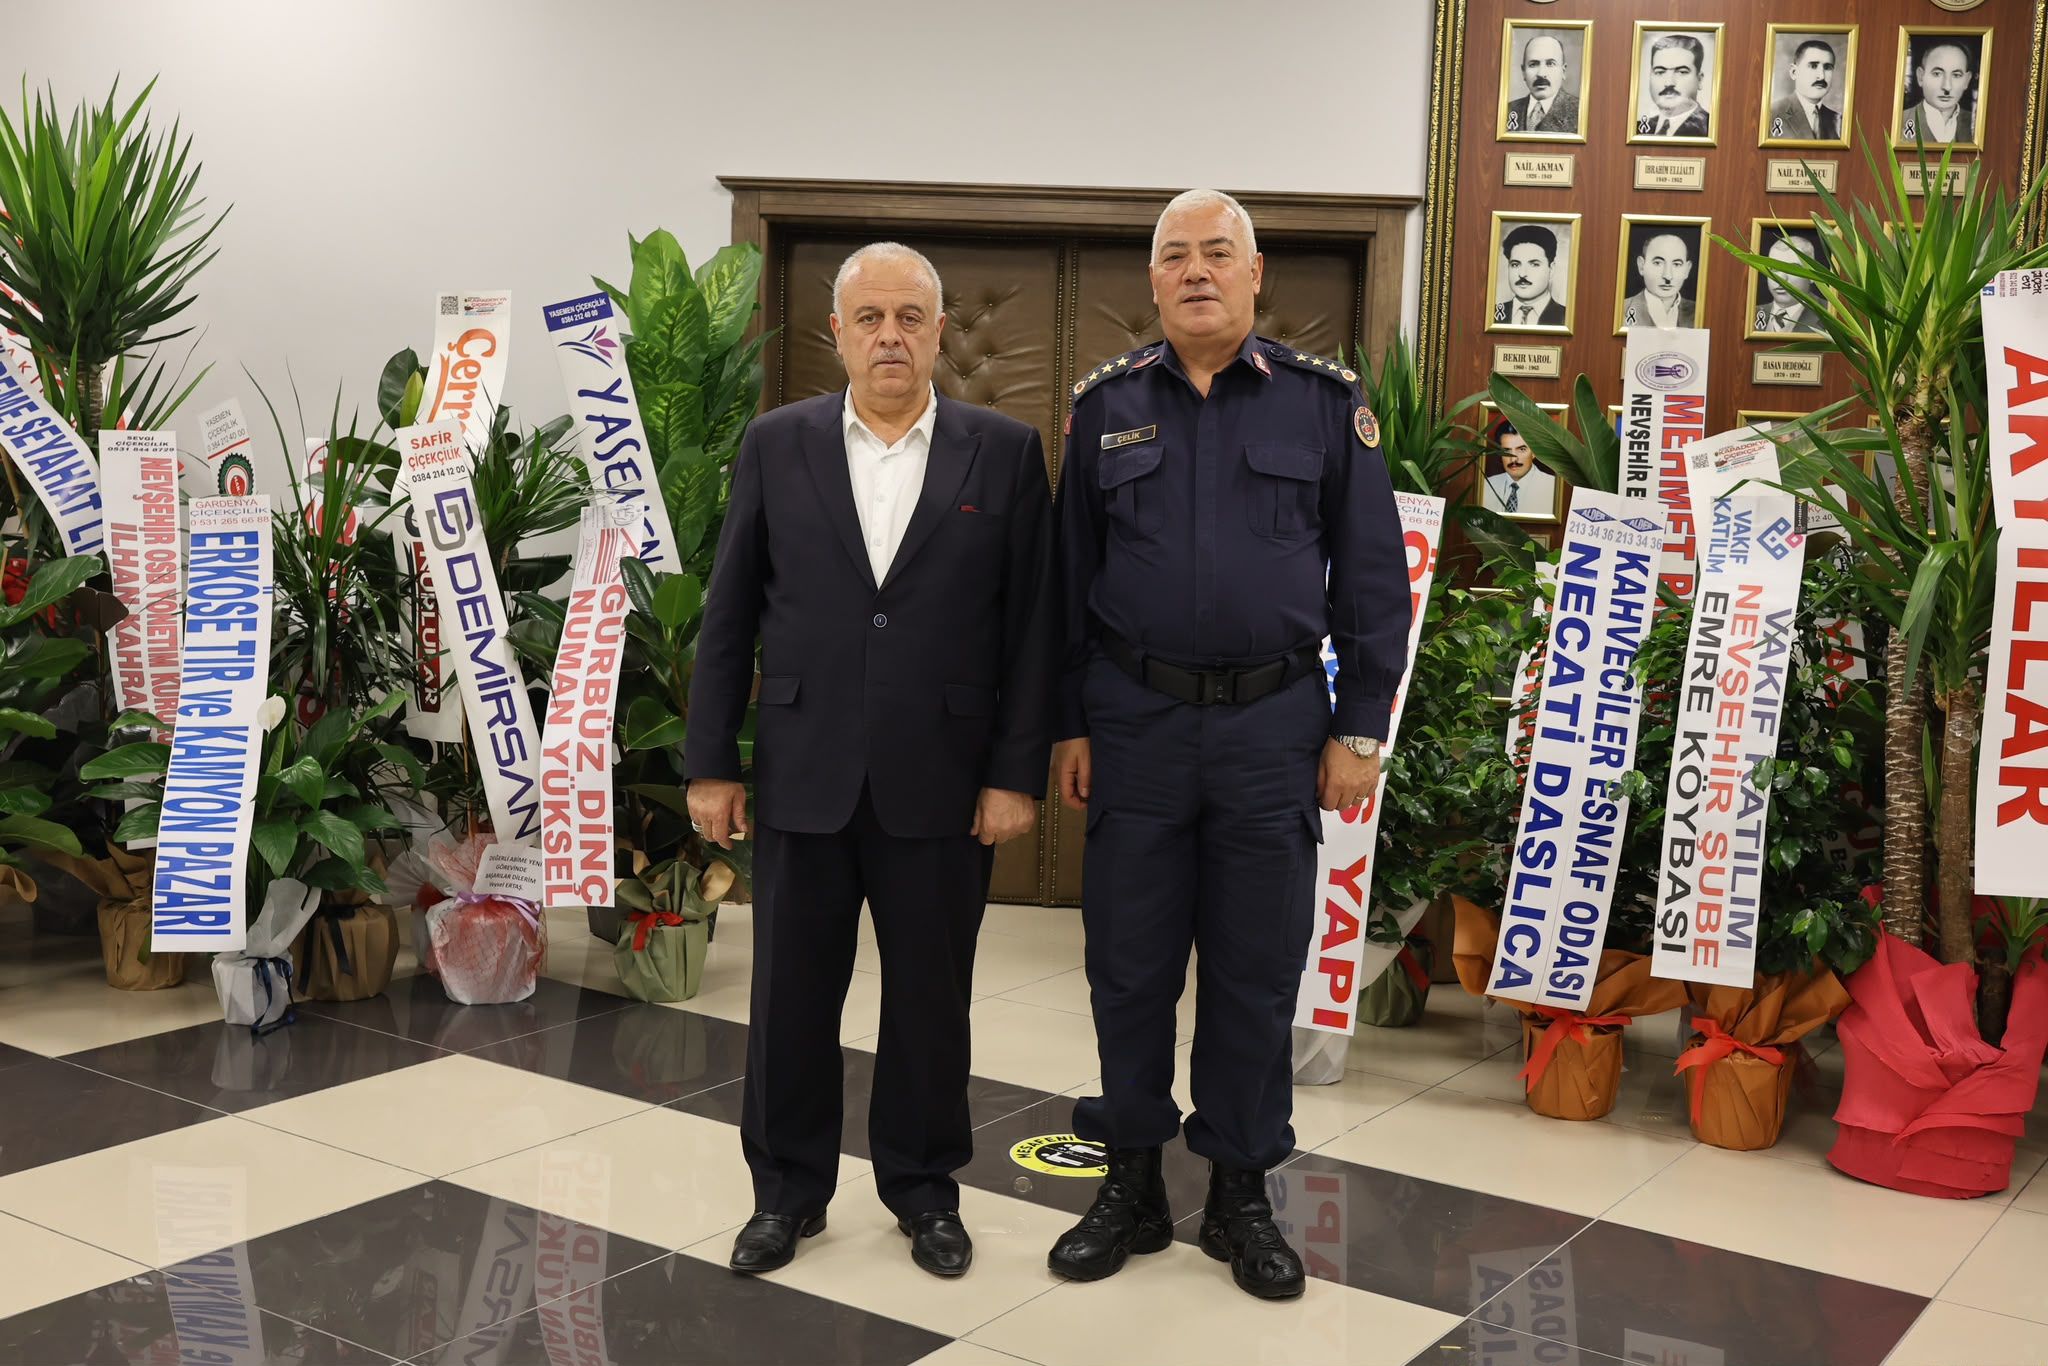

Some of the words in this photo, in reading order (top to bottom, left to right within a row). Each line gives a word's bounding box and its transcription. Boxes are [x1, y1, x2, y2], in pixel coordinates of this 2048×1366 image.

[1515, 160, 1534, 171] NAİL
[1536, 162, 1564, 172] AKMAN
[1777, 166, 1794, 178] NAİL
[547, 306, 576, 318] YASEMEN
[575, 298, 607, 313] ÇİÇEKÇİLİK
[574, 313, 584, 321] 212
[443, 328, 497, 427] Çerr
[1527, 354, 1552, 364] VAROL
[1762, 360, 1782, 370] HASAN
[205, 409, 232, 428] YASEMEN
[207, 418, 239, 441] ÇİÇEKÇİLİK
[408, 445, 462, 471] ÇİÇEKÇİLİK
[410, 430, 452, 450] SAFİR
[1117, 431, 1141, 445] ÇELİK
[1624, 393, 1653, 483] NEVŞEHİR
[2, 416, 103, 517] SEYAHAT
[133, 456, 177, 546] NEVŞEHİR
[195, 498, 258, 510] GARDENYA
[411, 472, 432, 483] 0384
[432, 468, 446, 479] 214
[446, 467, 455, 476] 12
[455, 464, 467, 474] 00
[1656, 394, 1706, 562] MEHMET
[190, 506, 269, 518] ÇİÇEKÇİLİK
[198, 517, 218, 526] 531
[220, 517, 240, 526] 265
[241, 517, 256, 525] 66
[256, 516, 270, 525] 88
[1569, 520, 1587, 536] 213
[1588, 525, 1601, 539] 34
[1601, 528, 1615, 542] 36
[1615, 531, 1634, 546] 213
[1635, 534, 1649, 548] 34
[1650, 537, 1663, 551] 36
[1705, 497, 1732, 574] KATILIM
[1729, 510, 1753, 566] VAKIF
[110, 522, 143, 607] İLHAN
[144, 549, 177, 585] OSB
[186, 530, 273, 633] ERKÖSE
[114, 612, 148, 711] KAHRA
[145, 590, 183, 668] YÖNETİM
[181, 639, 257, 684] TIR
[546, 588, 597, 726] NUMAN
[1540, 541, 1602, 744] NECATİ
[1589, 550, 1652, 769] KAHVECİLER
[1686, 591, 1730, 713] EMRE
[1750, 607, 1793, 737] VAKIF
[177, 689, 233, 718] ve
[446, 551, 542, 841] DEMİRSAN
[576, 583, 629, 774] GÜRBÜZ
[1705, 584, 1764, 813] NEVŞEHİR
[162, 725, 250, 833] KAMYON
[541, 741, 576, 907] YÜKSEL
[496, 863, 528, 873] GÖREVİNDE
[573, 789, 614, 907] DİNÇ
[1494, 761, 1572, 990] DAŞLICA
[1569, 777, 1619, 893] ESNAF
[1657, 730, 1708, 953] KÖYBAŞI
[153, 842, 235, 936] PAZARI
[1692, 830, 1728, 968] ŞUBE
[1312, 854, 1367, 1031] YAPI
[1545, 901, 1600, 1001] ODASI
